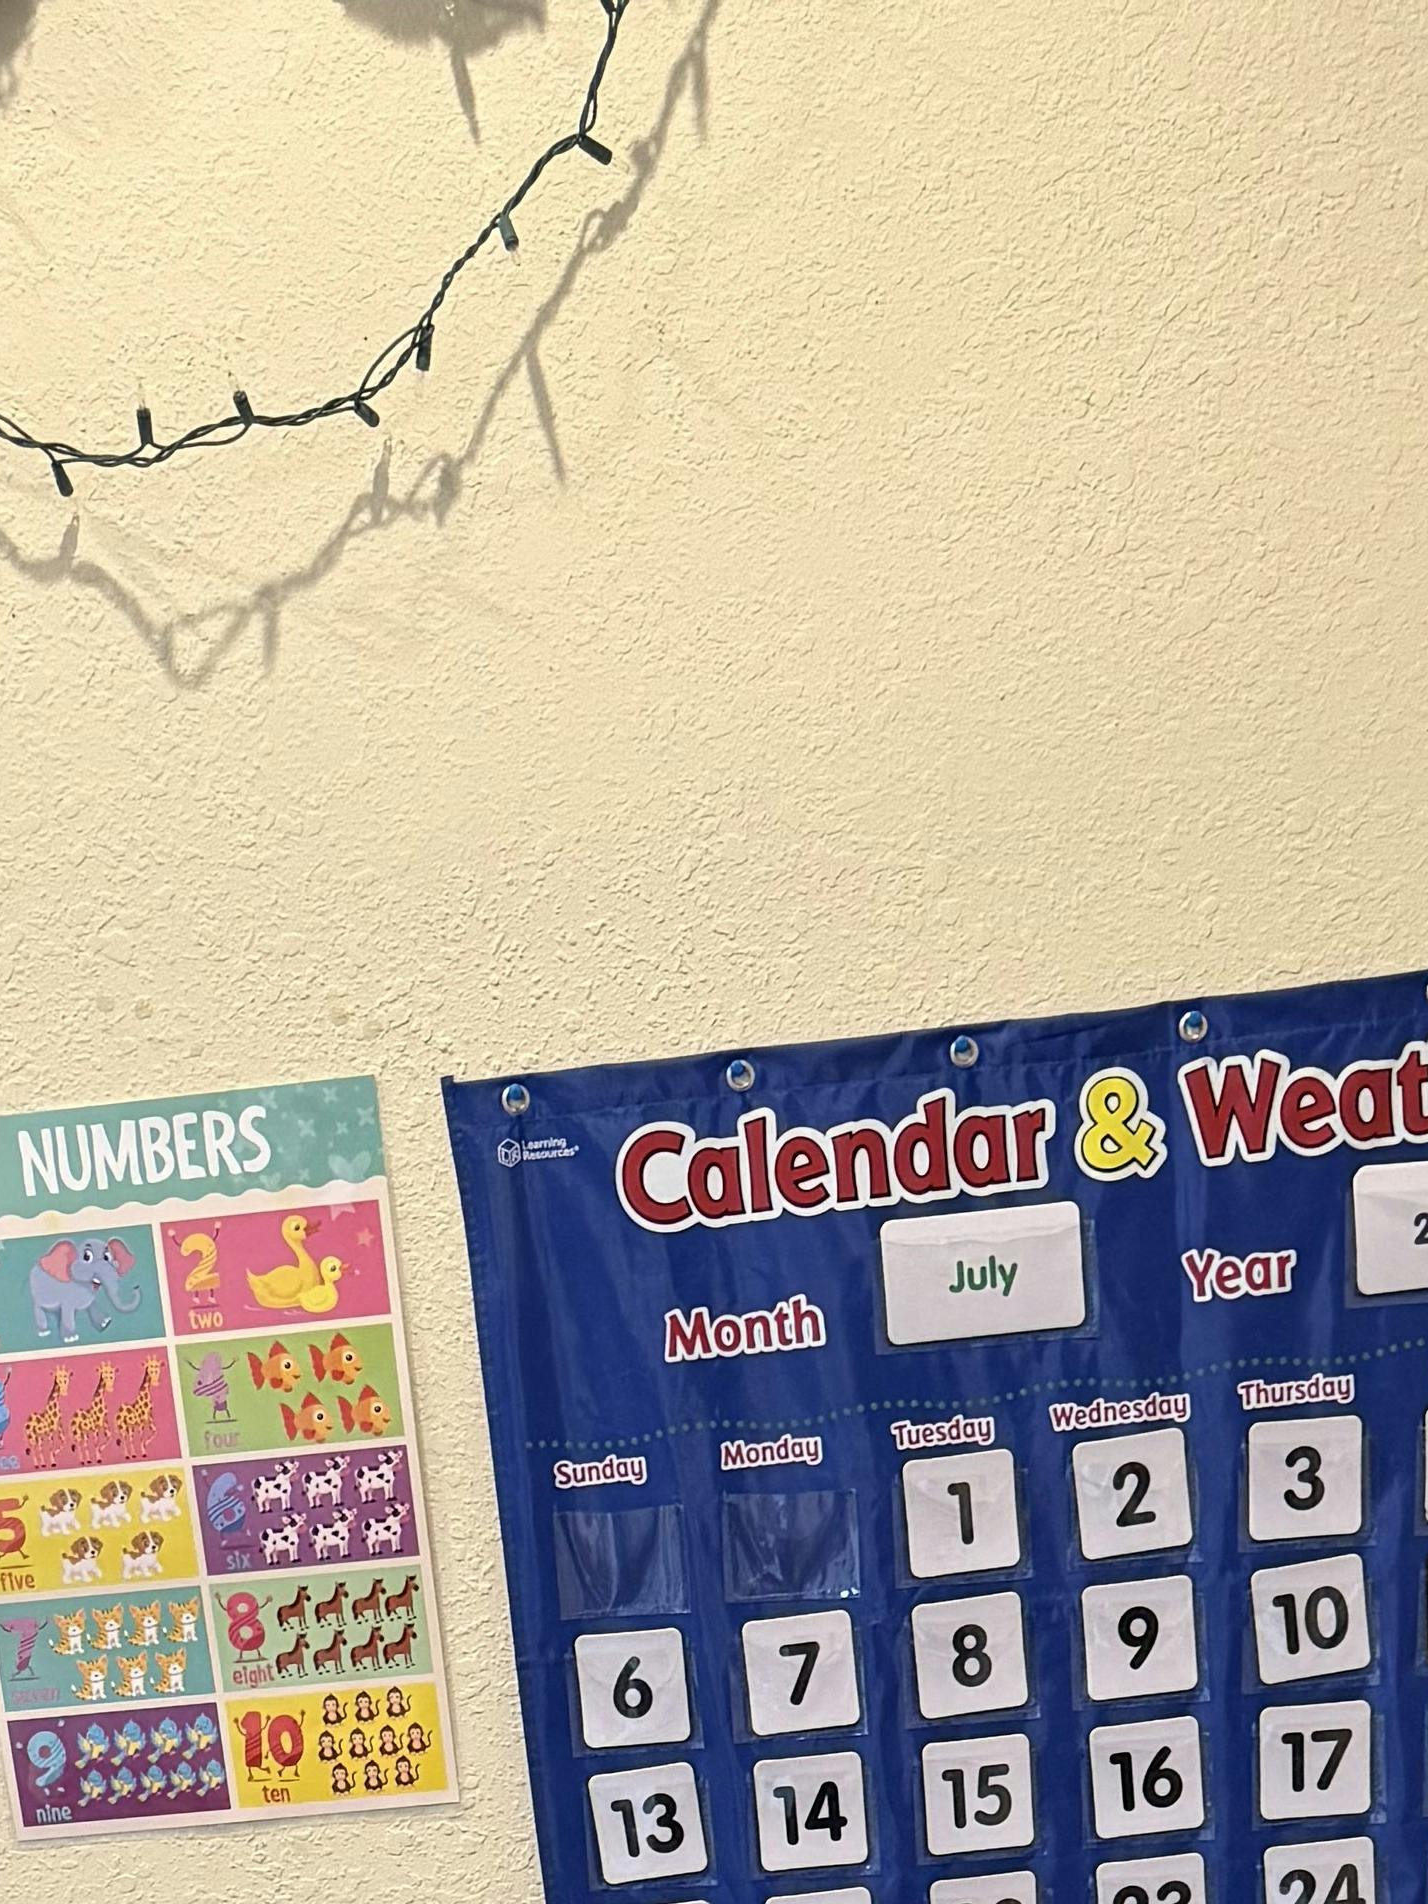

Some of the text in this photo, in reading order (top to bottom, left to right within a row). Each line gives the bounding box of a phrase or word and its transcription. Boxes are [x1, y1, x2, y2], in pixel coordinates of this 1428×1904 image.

[18, 1105, 273, 1198] NUMBERS
[619, 1092, 1051, 1229] Calendar
[1077, 1071, 1165, 1178] &
[949, 1256, 1018, 1297] July
[1184, 1250, 1296, 1302] Year
[188, 1309, 224, 1331] two
[666, 1296, 825, 1361] Month
[555, 1455, 647, 1487] Sunday
[722, 1436, 822, 1469] Monday
[893, 1416, 993, 1449] Tuesday
[1051, 1391, 1190, 1436] Wednesday
[1239, 1375, 1354, 1409] Thursday
[948, 1482, 974, 1544] 1
[1113, 1462, 1156, 1527] 2
[1284, 1446, 1324, 1510] 3
[0, 1571, 36, 1592] five
[231, 1660, 274, 1686] eight
[613, 1657, 653, 1718] 6
[779, 1642, 820, 1705] 7
[953, 1624, 992, 1687] 8
[1118, 1606, 1158, 1669] 9
[1273, 1586, 1348, 1654] 10
[36, 1802, 72, 1823] nine
[262, 1783, 291, 1804] ten
[611, 1793, 684, 1857] 13
[773, 1781, 847, 1845] 14
[942, 1764, 1011, 1828] 15
[1110, 1746, 1183, 1811] 16
[1281, 1729, 1352, 1792] 17
